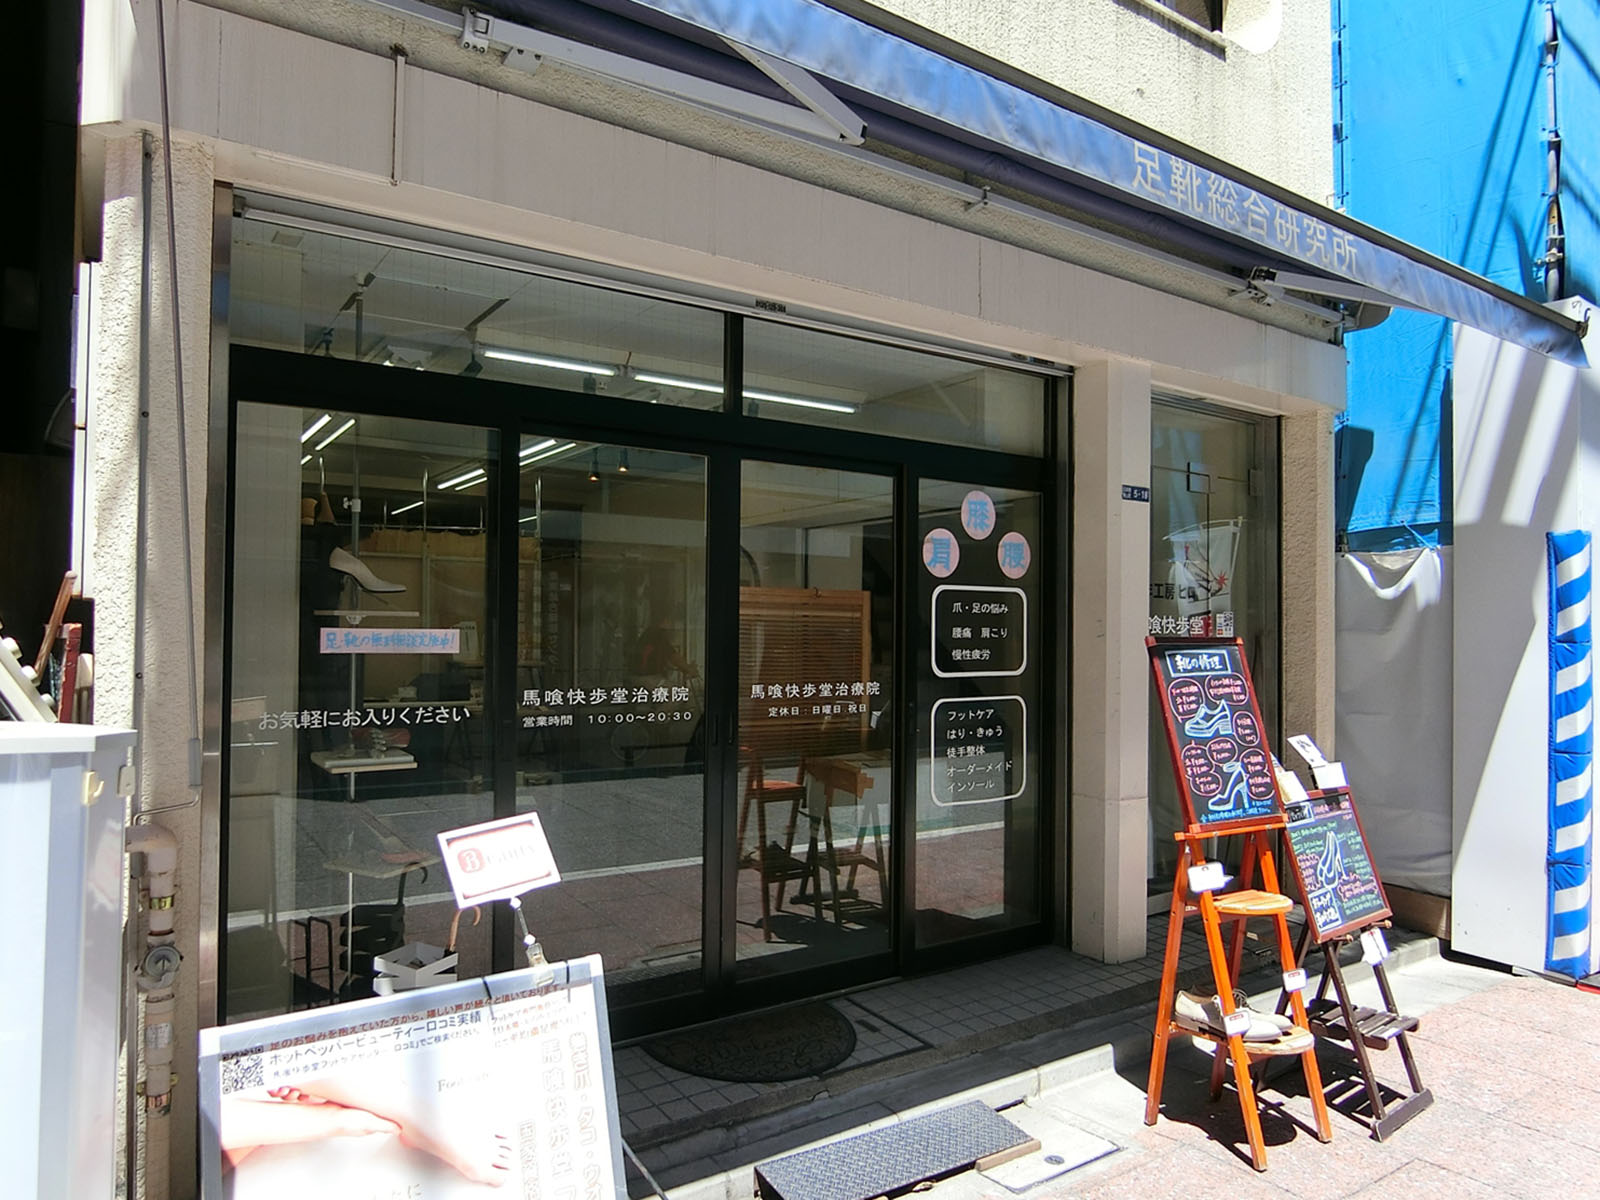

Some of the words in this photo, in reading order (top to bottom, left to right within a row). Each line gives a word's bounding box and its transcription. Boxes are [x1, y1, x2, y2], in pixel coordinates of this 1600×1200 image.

[1132, 141, 1358, 274] 足靴総合研究所
[967, 499, 990, 532] 膝
[927, 535, 952, 571] 肩
[1001, 541, 1025, 571] 腰
[1149, 583, 1176, 600] 工房
[951, 602, 1009, 614] 爪・足の悩み
[951, 627, 972, 639] 腰痛
[980, 627, 1008, 639] 肩こり
[951, 649, 991, 661] 慢性疲労
[1174, 653, 1223, 672] 靴の修理
[522, 686, 690, 707] 馬喰快歩堂治療院
[750, 681, 881, 700] 馬喰快歩堂治療院
[258, 705, 471, 730] お気軽にお入りください
[522, 714, 573, 728] 営業時間
[947, 709, 995, 722] フットケア
[946, 725, 1003, 740] はり・きゅう
[946, 744, 986, 759] 徒手整体
[946, 760, 1013, 777] オーダーメイド
[947, 779, 995, 793] インソール
